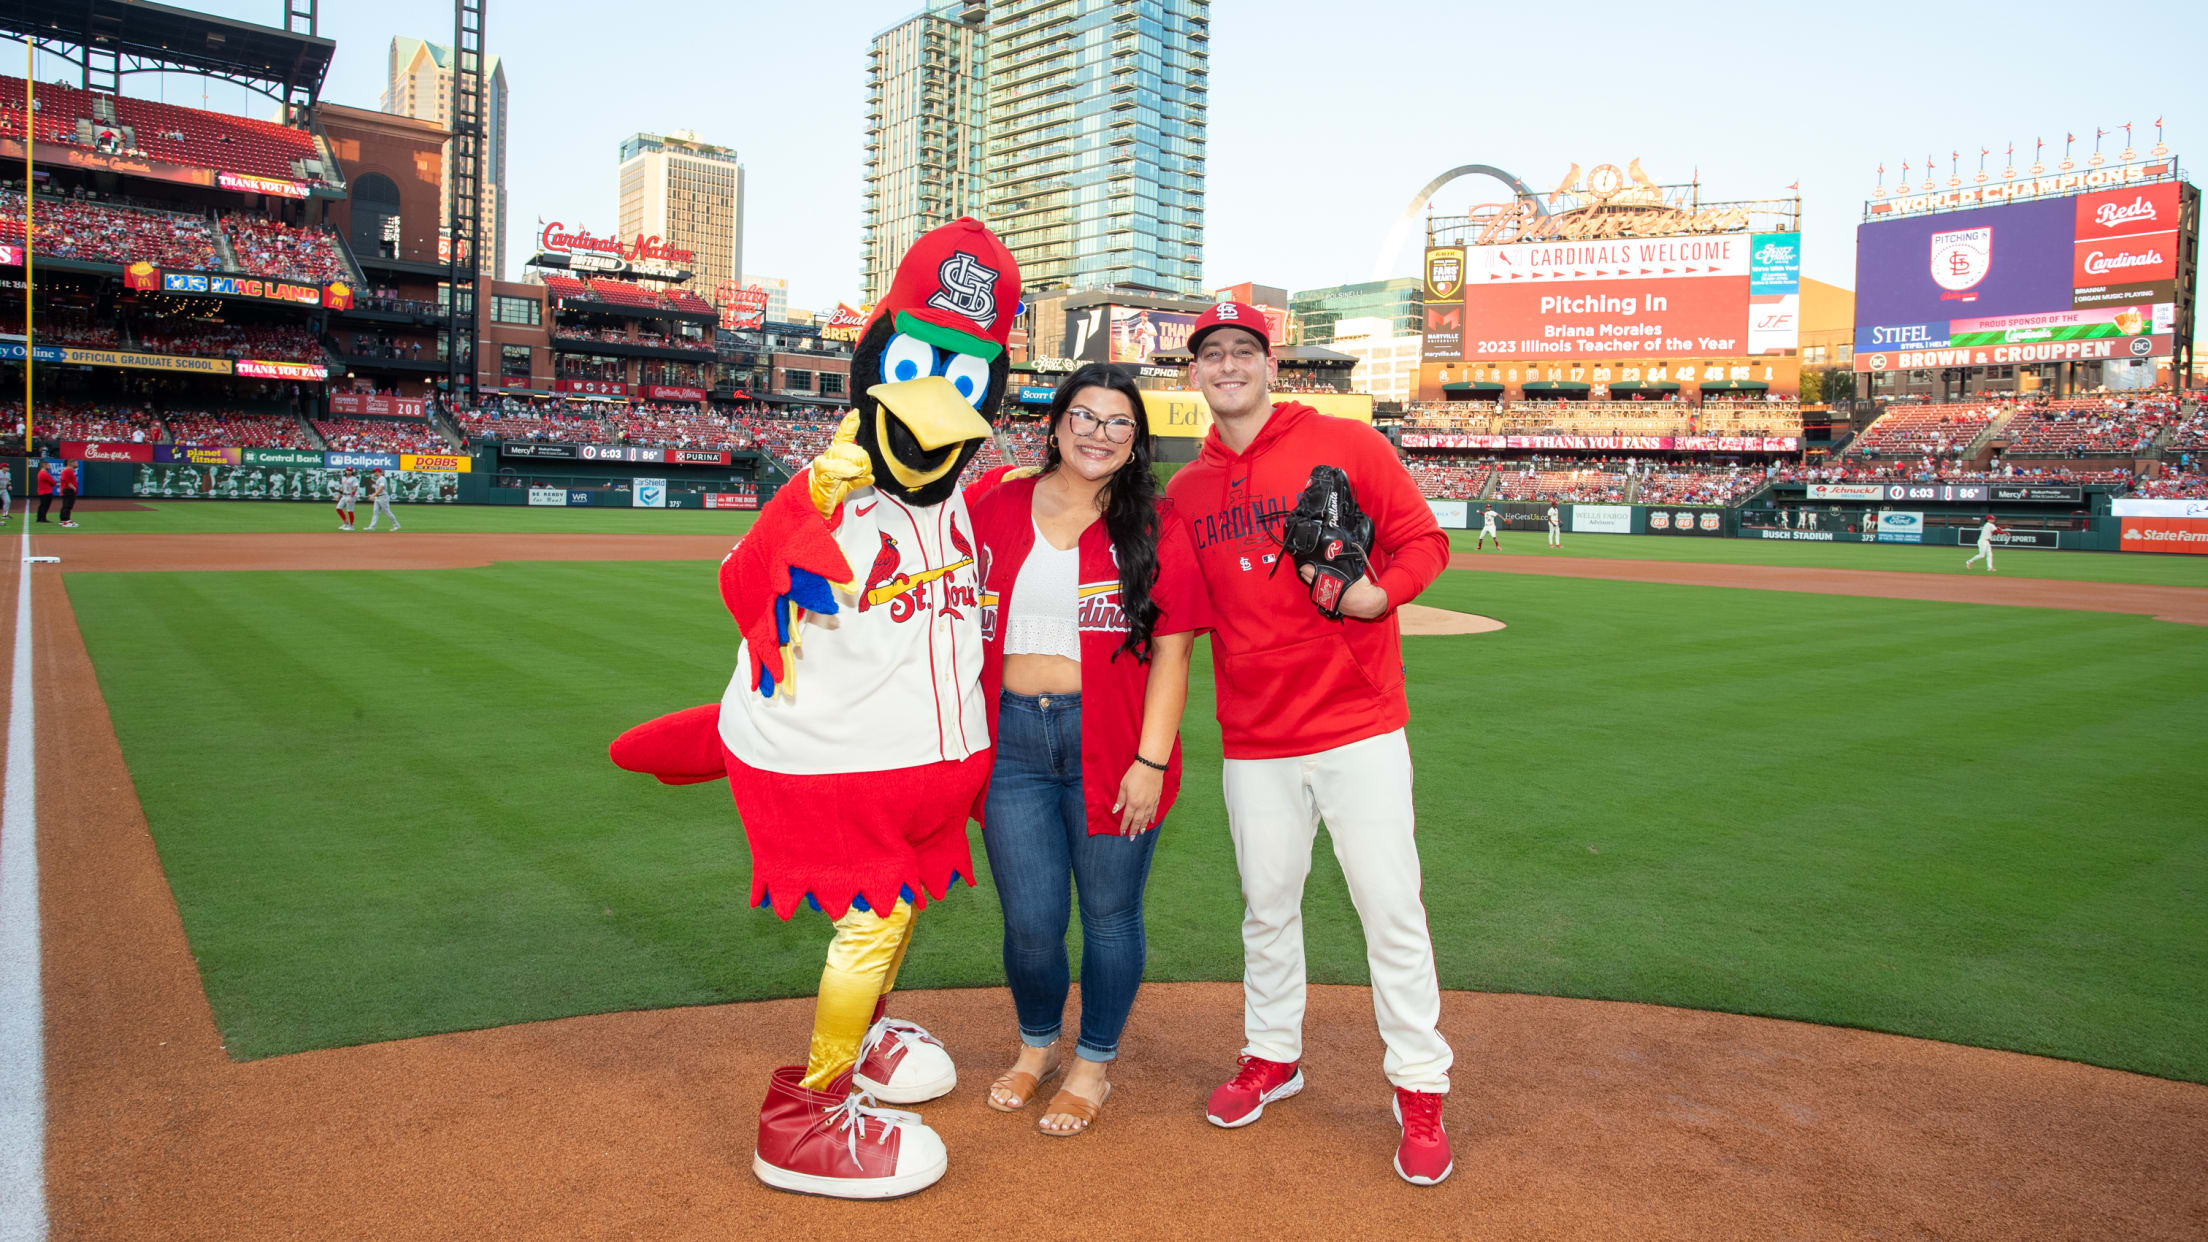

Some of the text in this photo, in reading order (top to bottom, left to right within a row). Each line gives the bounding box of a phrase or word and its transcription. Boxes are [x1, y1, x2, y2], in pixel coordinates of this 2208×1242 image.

[218, 175, 311, 197] THANK YOU FANS
[1889, 165, 2146, 214] WORLD CHAMPIONS
[2095, 196, 2158, 228] Reds
[1469, 199, 1751, 246] Budweiser
[542, 222, 692, 263] Cardinals Nation
[1935, 231, 1979, 244] PITCHING
[1531, 246, 1631, 267] CARDINALS
[1640, 241, 1732, 262] WELCOME
[570, 254, 618, 270] HOFFMANN
[2084, 249, 2164, 274] Cardinals
[632, 263, 680, 277] ROOFTOP
[164, 273, 320, 305] BIG MAC LAND
[714, 280, 770, 310] Bally
[727, 303, 756, 314] SPORTS
[1540, 294, 1668, 316] Pitching In
[1158, 321, 1195, 335] THAN
[1979, 314, 2079, 328] PROUD SPONSOR OF THE
[1544, 323, 1663, 338] Briana Morales
[1872, 325, 1932, 345] STIFEL
[2004, 328, 2053, 343] Cardinals
[1477, 337, 1736, 354] 2023 Illinois Teacher of the Year
[72, 351, 117, 364] OFFICIAL
[120, 354, 173, 368] GRADUATE
[175, 358, 213, 371] SCHOOL
[1899, 349, 1971, 369] BROWN
[1975, 351, 1988, 364] &
[1994, 341, 2111, 363] CROUPPEN
[2133, 342, 2149, 352] BC
[236, 363, 328, 379] THANK YOU FANS
[1547, 368, 1562, 382] 14
[1570, 368, 1585, 382] 17
[1592, 367, 1611, 382] 20
[1622, 367, 1640, 382] 23
[1647, 366, 1667, 382] 24
[1675, 366, 1695, 382] 42
[1703, 366, 1724, 381] 45
[1022, 391, 1049, 399] SCOTT
[397, 403, 421, 415] 208
[1533, 436, 1660, 450] THANK YOU FANS
[186, 447, 221, 459] planet
[511, 446, 531, 455] Mercy
[600, 448, 658, 460] 6:03 86°
[686, 453, 719, 461] PURINA
[191, 455, 228, 464] fitness
[259, 453, 322, 464] Central Bank
[343, 455, 392, 467] Ballpark
[415, 456, 458, 467] DOBBS
[633, 478, 666, 487] CarShield
[572, 493, 588, 501] WR
[1909, 487, 1980, 498] 6:03 86°
[1998, 491, 2021, 500] Mercy
[1328, 491, 1339, 528] Pallante
[1575, 511, 1629, 521] WELLS FARGO
[1193, 492, 1306, 550] CARDINAL
[1889, 515, 1912, 525] Ford
[1762, 530, 1833, 541] BUSCH STADIUM
[1989, 534, 2037, 545] ally SPORTS
[891, 573, 932, 623] St.
